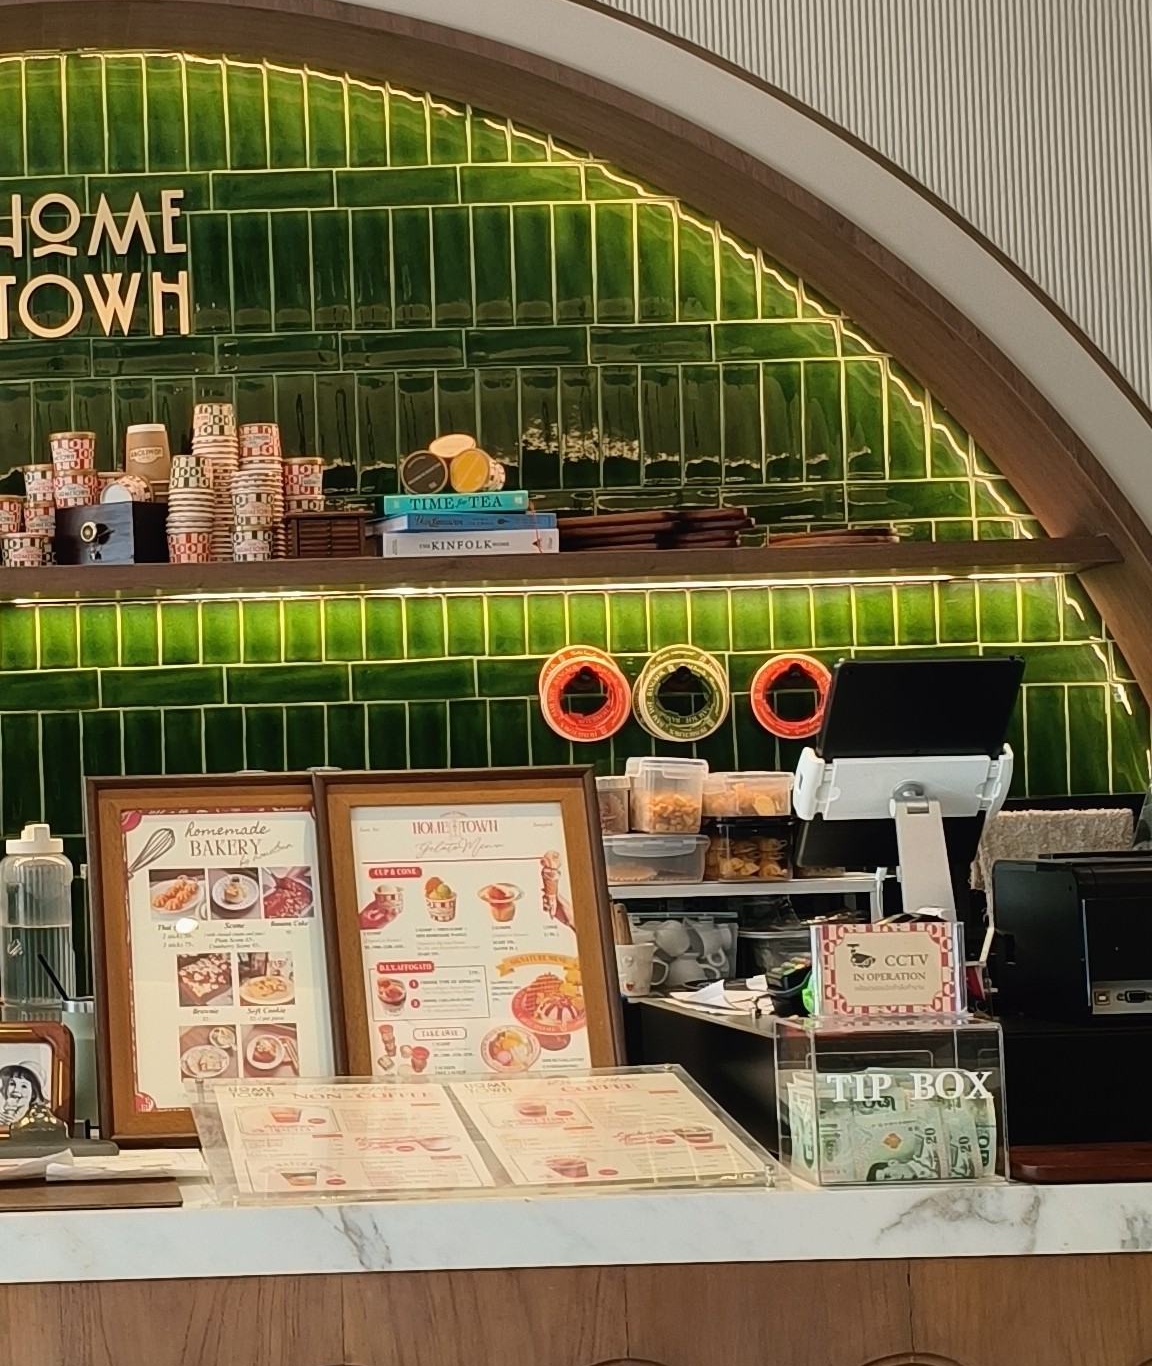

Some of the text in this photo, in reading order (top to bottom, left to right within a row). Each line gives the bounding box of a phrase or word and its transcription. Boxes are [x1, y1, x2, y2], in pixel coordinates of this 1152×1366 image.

[410, 497, 455, 511] TIME
[470, 496, 503, 508] TEA
[431, 539, 493, 551] KINFOLK
[185, 821, 270, 838] homemade
[412, 820, 499, 835] HOME TOWN
[190, 838, 262, 857] BAKERY
[884, 954, 929, 967] CCTV
[853, 972, 926, 982] IN OPERATION
[826, 1071, 995, 1103] TIP BOX
[924, 1127, 937, 1146] 20
[958, 1136, 972, 1154] 20
